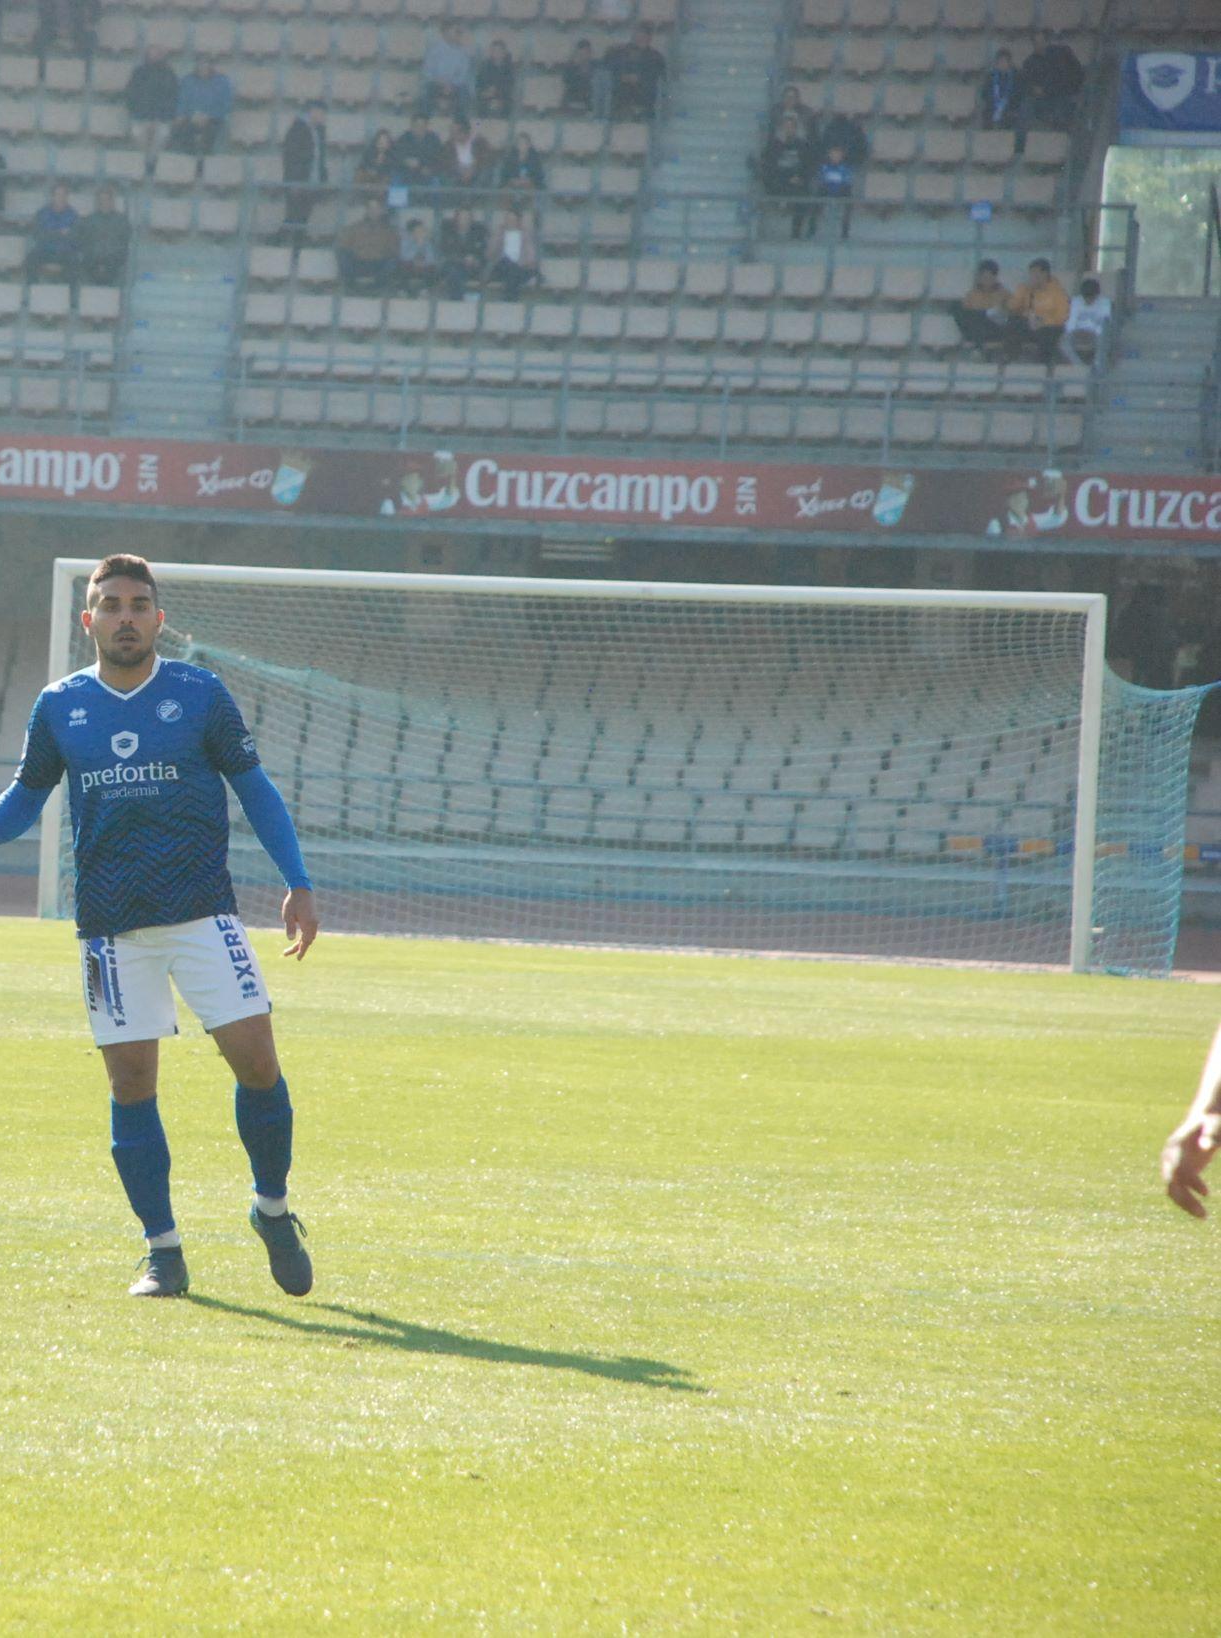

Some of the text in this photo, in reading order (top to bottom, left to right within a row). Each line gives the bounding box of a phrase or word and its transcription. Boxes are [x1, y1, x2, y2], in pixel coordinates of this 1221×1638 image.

[138, 454, 159, 492] SIN
[465, 459, 719, 520] Cruzcampo
[736, 475, 757, 514] SIN
[81, 761, 179, 792] prefortia
[100, 785, 159, 800] academia
[216, 914, 256, 981] XERE
